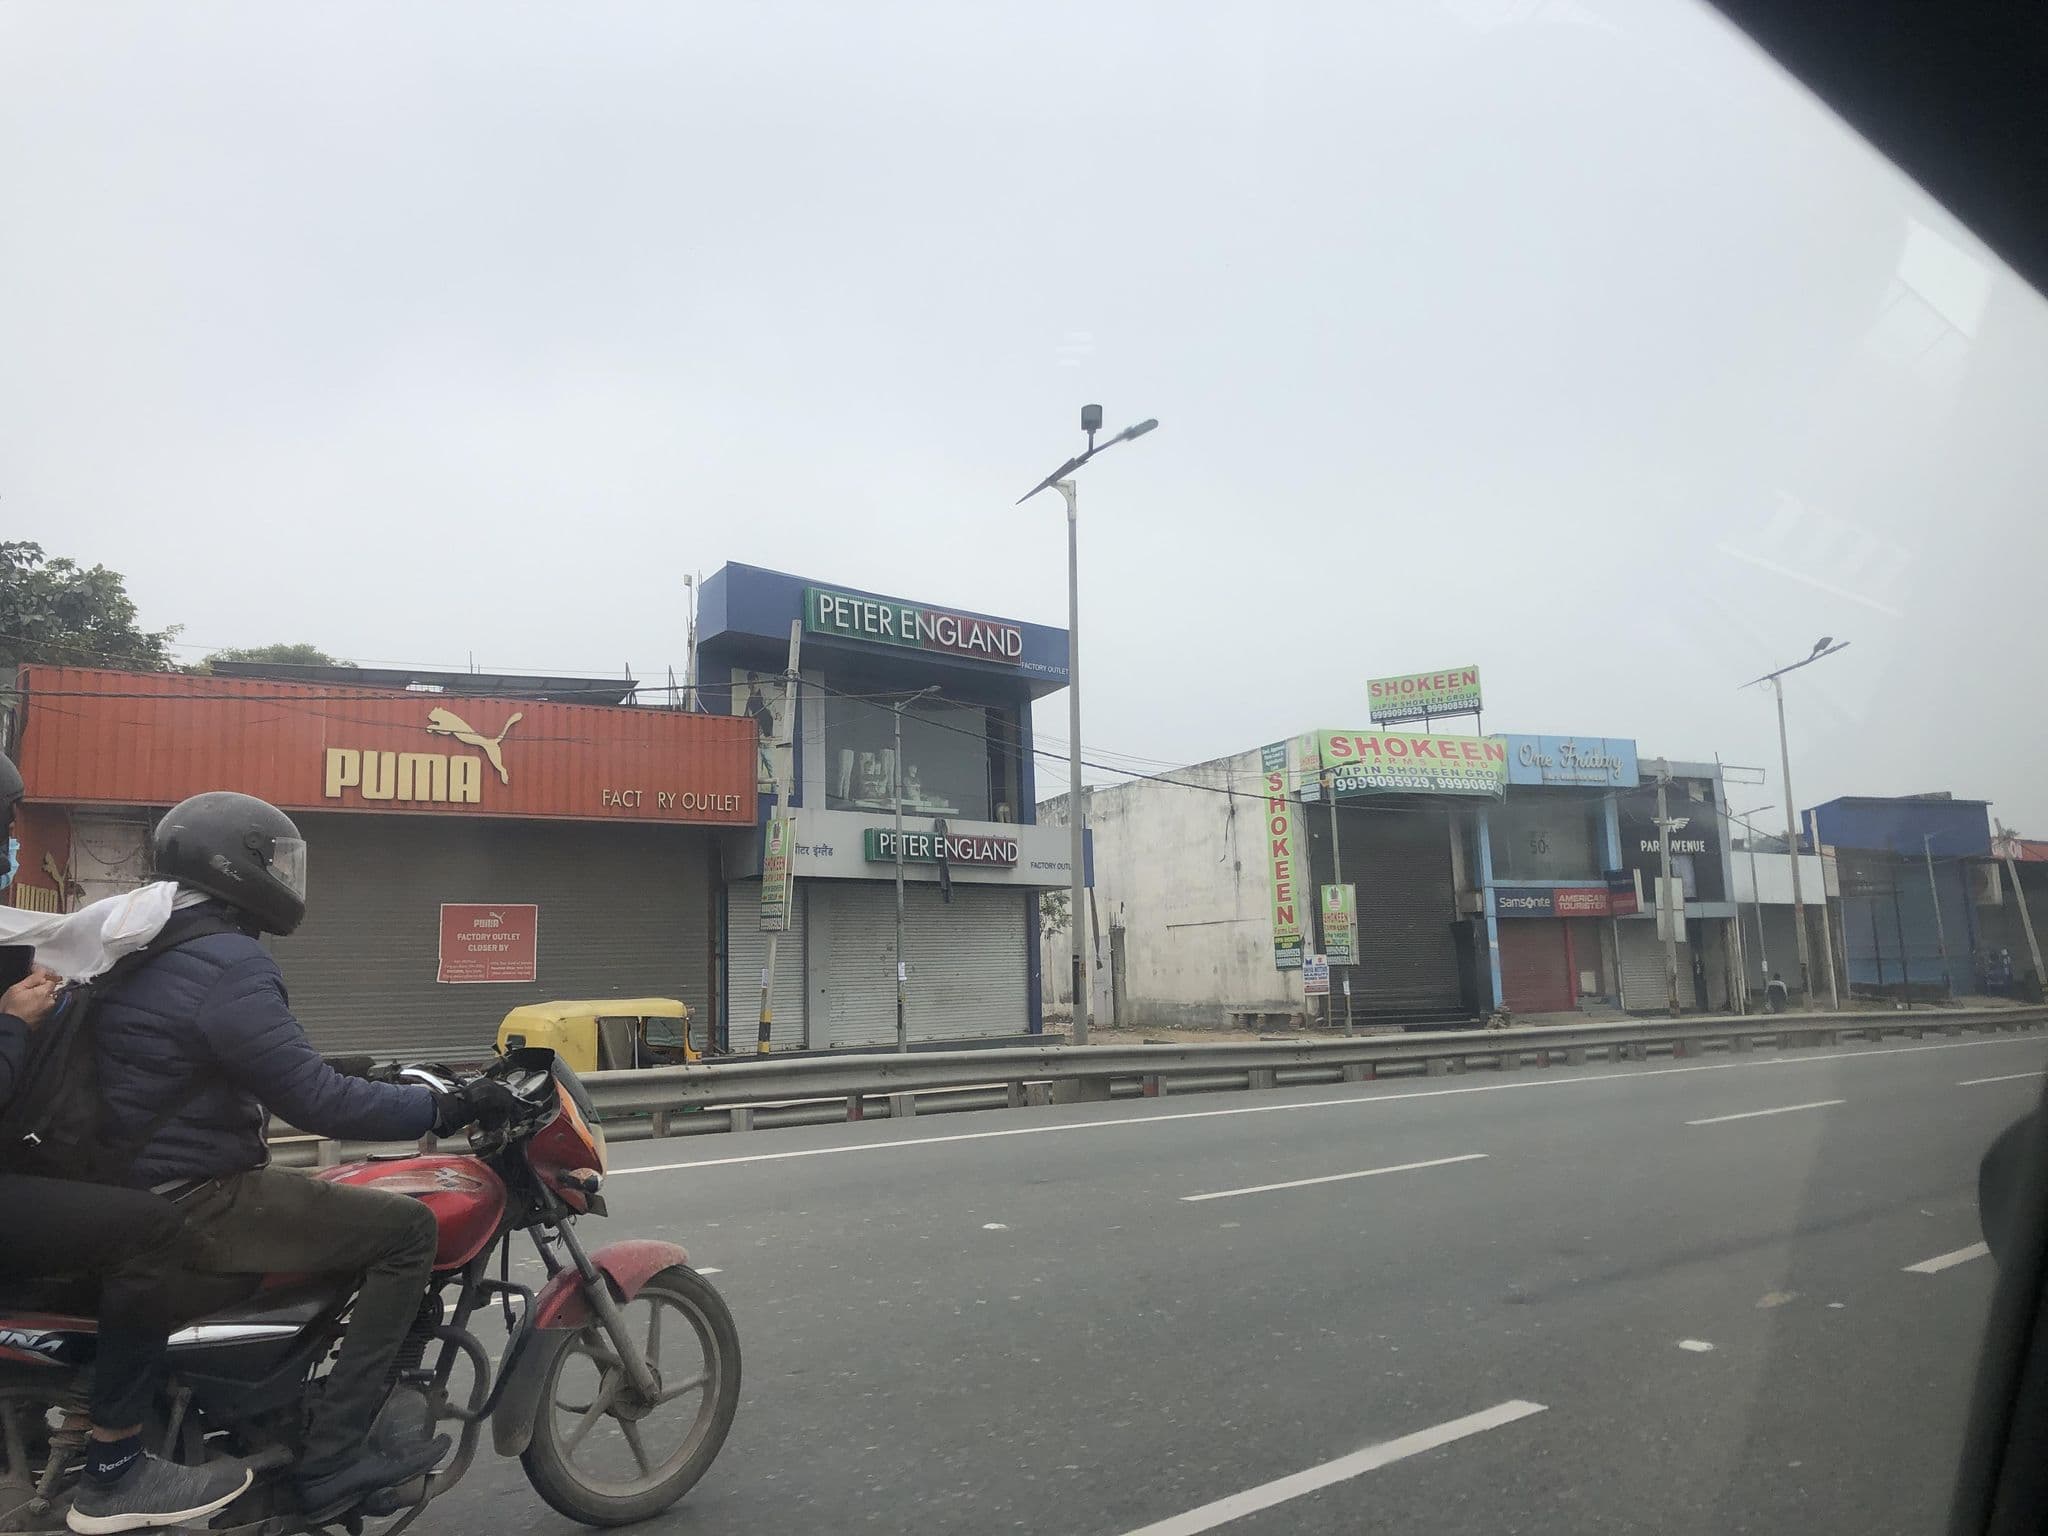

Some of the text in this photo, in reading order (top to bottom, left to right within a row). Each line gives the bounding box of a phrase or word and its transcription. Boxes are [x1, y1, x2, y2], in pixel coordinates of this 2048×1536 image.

[819, 594, 1023, 657] PETER ENGLAND
[1021, 661, 1069, 675] FACTORY OUTLET
[1370, 670, 1476, 698] SHOKEEN
[1401, 696, 1444, 707] SHOKEEN
[1447, 692, 1478, 701] GROUP
[1427, 699, 1479, 713] 9999085929
[1328, 736, 1505, 763] SHOKEEN
[1519, 744, 1553, 768] One
[1360, 756, 1489, 769] FARMS LAND
[325, 748, 481, 803] PUMA
[1334, 766, 1381, 777] VIPIN
[1387, 766, 1460, 777] SHOKEEN
[1336, 775, 1435, 792] 9999095929,
[681, 792, 741, 811] OUTLET
[880, 833, 1019, 862] PETER ENGLAND
[1268, 771, 1294, 925] SHOKEEN
[1640, 840, 1706, 853] PAR AVENUE
[1030, 861, 1056, 869] FACTORY
[1499, 897, 1551, 909] Samsonite
[1559, 894, 1608, 902] AMERICAN
[1559, 902, 1607, 910] TOURISTER
[457, 933, 520, 941] FACTORY OUTLET
[468, 944, 509, 952] CLOSER BY
